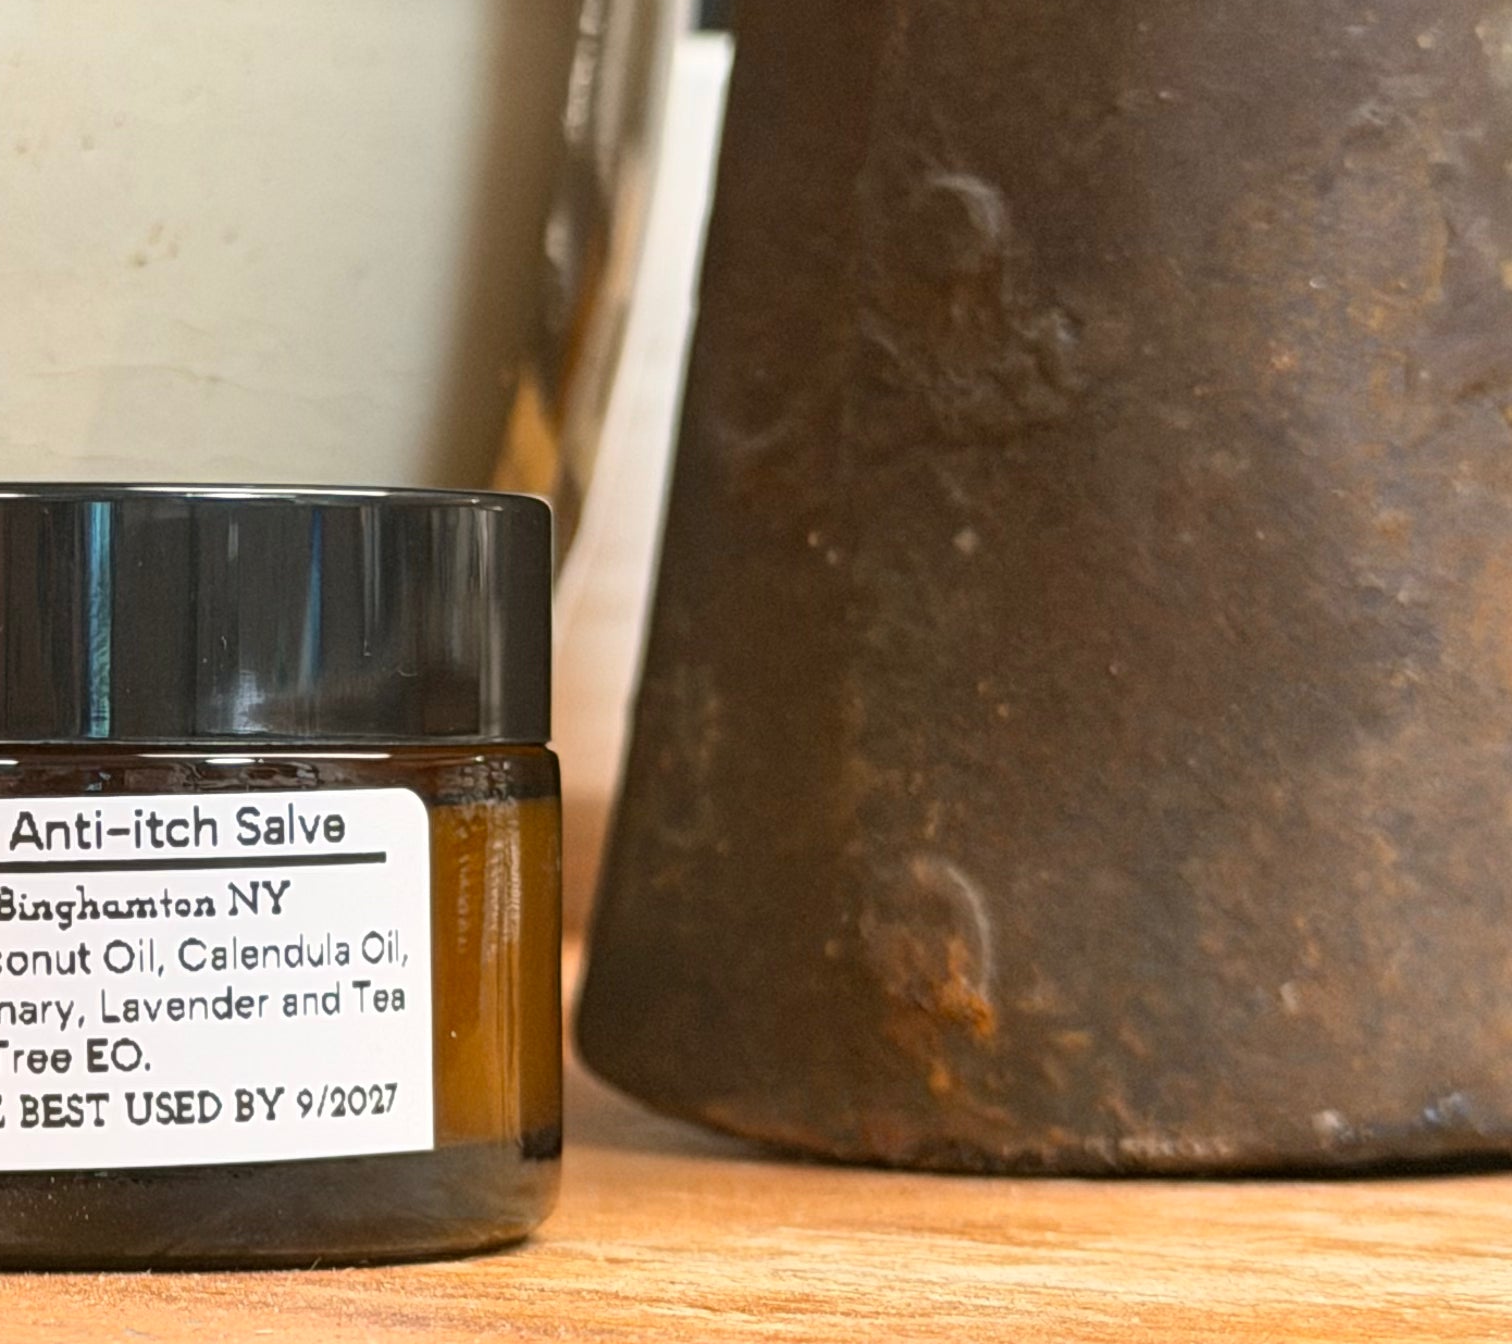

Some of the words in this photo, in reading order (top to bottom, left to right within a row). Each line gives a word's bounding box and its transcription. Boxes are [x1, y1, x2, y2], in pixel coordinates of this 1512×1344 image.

[10, 806, 217, 851] Anti-itch
[236, 803, 345, 846] Salve
[228, 880, 290, 916] NY
[104, 939, 163, 976] Oil,
[179, 934, 349, 971] Calendula
[362, 931, 407, 965] Oil,
[102, 986, 268, 1023] Lavender
[283, 983, 339, 1017] and
[353, 980, 404, 1012] Tea
[87, 1038, 150, 1073] EO.
[20, 1093, 109, 1128] BEST
[125, 1091, 222, 1125] USED
[235, 1087, 284, 1122] BY
[297, 1083, 397, 1117] 9/2027
